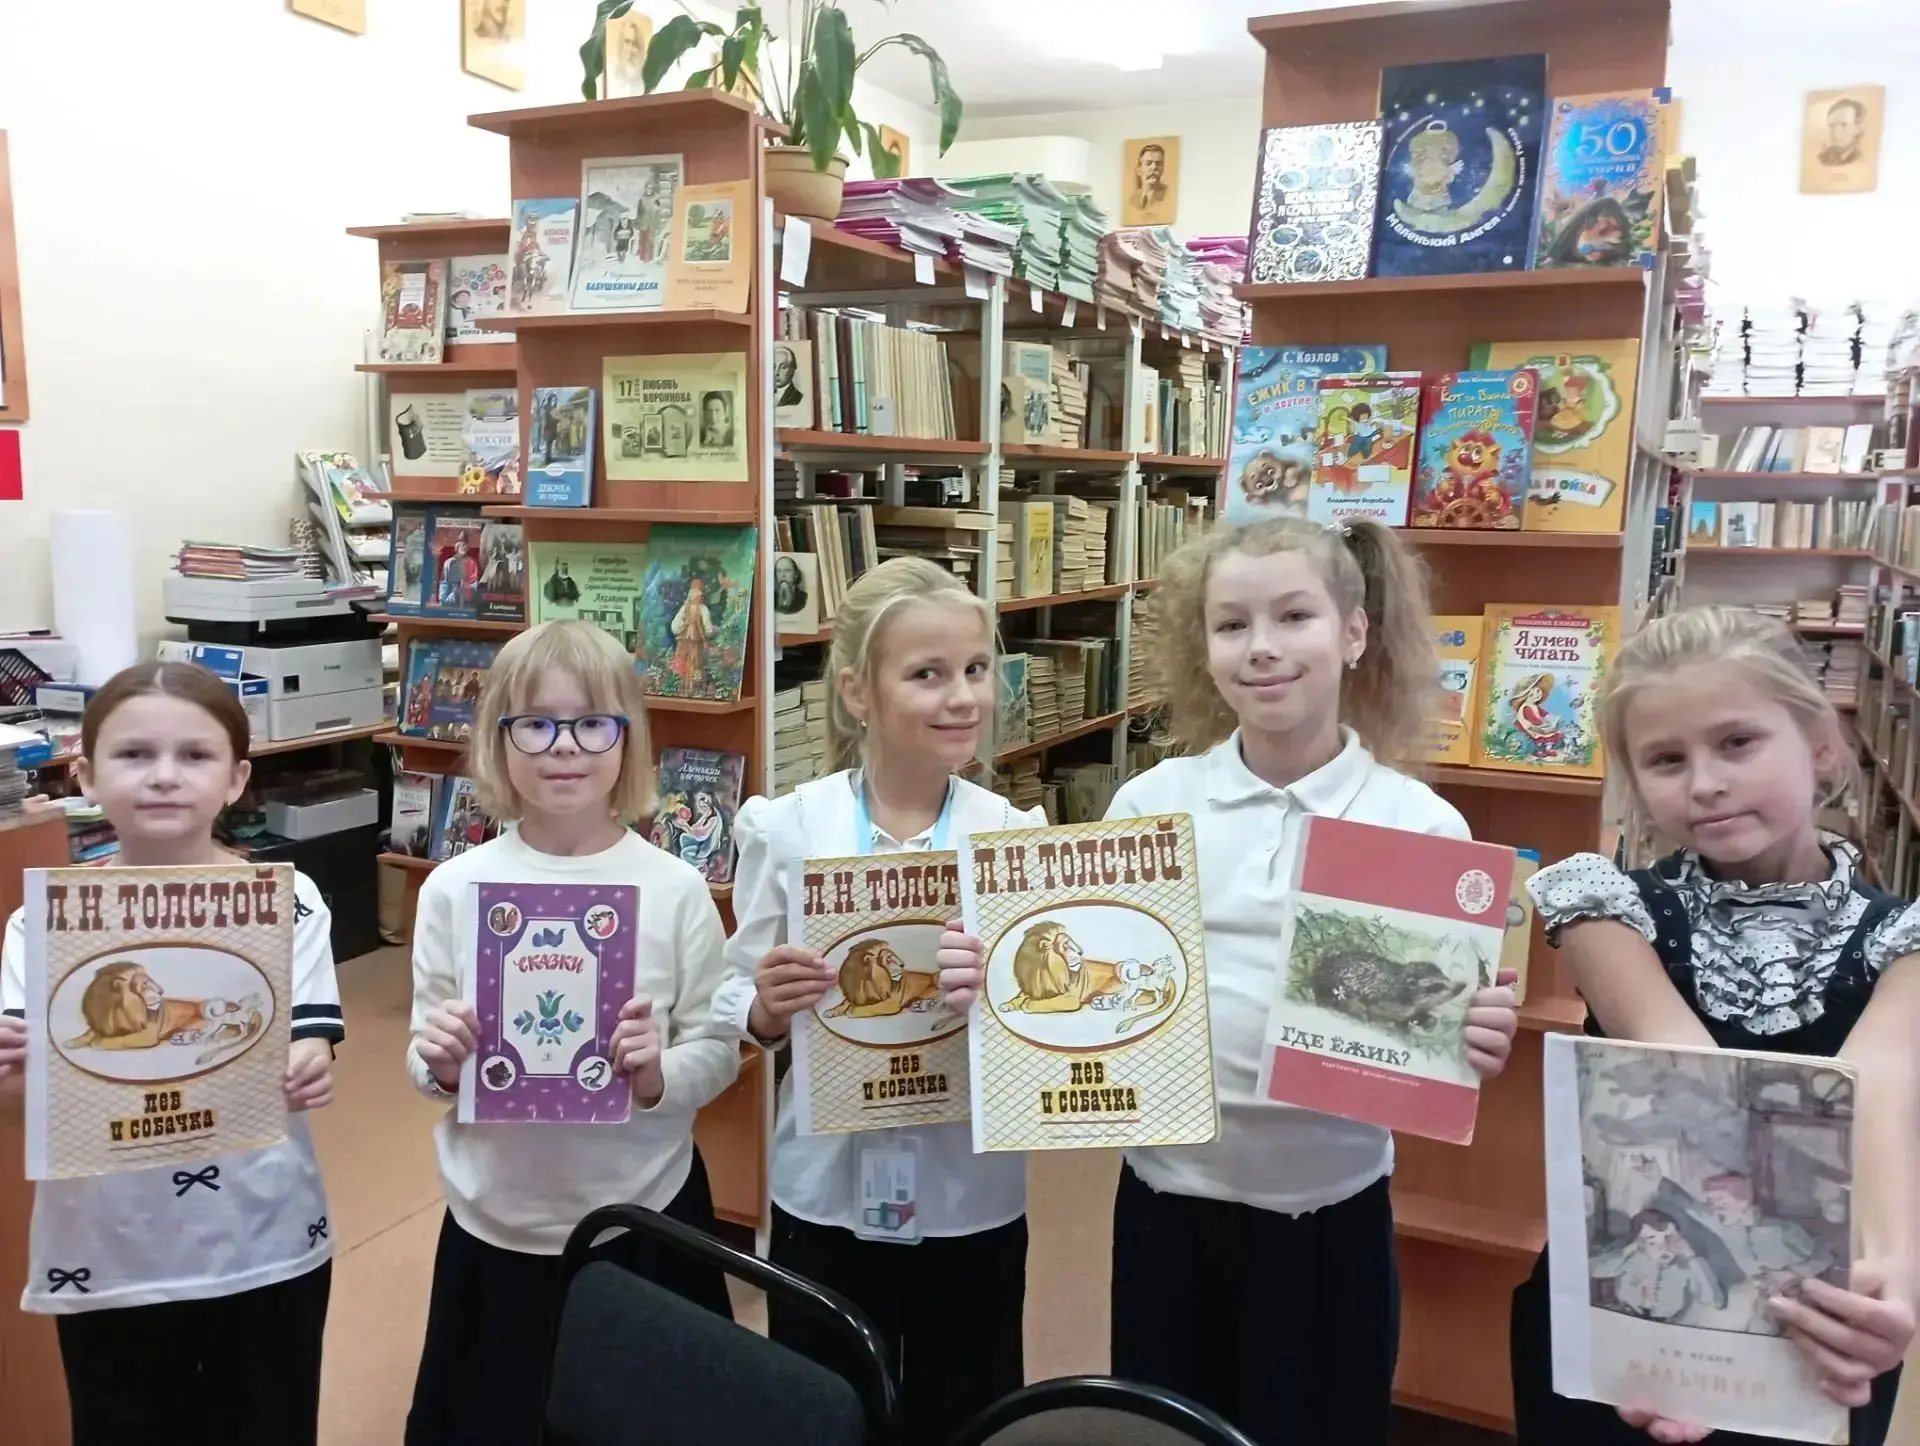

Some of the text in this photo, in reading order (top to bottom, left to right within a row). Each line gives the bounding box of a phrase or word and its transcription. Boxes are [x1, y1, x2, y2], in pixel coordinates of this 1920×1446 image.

[1575, 122, 1637, 156] 50
[1385, 213, 1457, 247] Маленький
[585, 281, 658, 292] БАБУШКИНЫ ДЕЛА
[1282, 351, 1340, 364] С. Козлов
[620, 380, 633, 397] 17
[642, 379, 679, 390] ЛЮБОВЬ
[1440, 387, 1465, 402] Кот
[643, 392, 692, 403] ВОРОНКОВА
[1559, 477, 1597, 496] ОЙКА
[1514, 630, 1579, 648] Я умею
[1515, 647, 1580, 662] читать
[678, 763, 721, 776] Аленький
[680, 773, 719, 783] цветочек
[1038, 818, 1183, 890] ТОЛСТОЙ
[866, 864, 959, 911] ТОЛСТ
[118, 868, 278, 931] ТОЛСТОЙ
[513, 953, 585, 974] СКАЗКИ
[1281, 1025, 1411, 1067] ГДЕ ЁЖИК?
[890, 1055, 920, 1075] ЛЕВ
[1070, 1062, 1104, 1085] ЛЕВ
[879, 1074, 948, 1099] СОБАЧКА
[144, 1090, 182, 1114] ЛЕВ
[1058, 1088, 1137, 1113] СОБАЧКА
[130, 1109, 214, 1140] СОБАЧКА
[1627, 1357, 1767, 1398] МАЛЬЧИКИ
